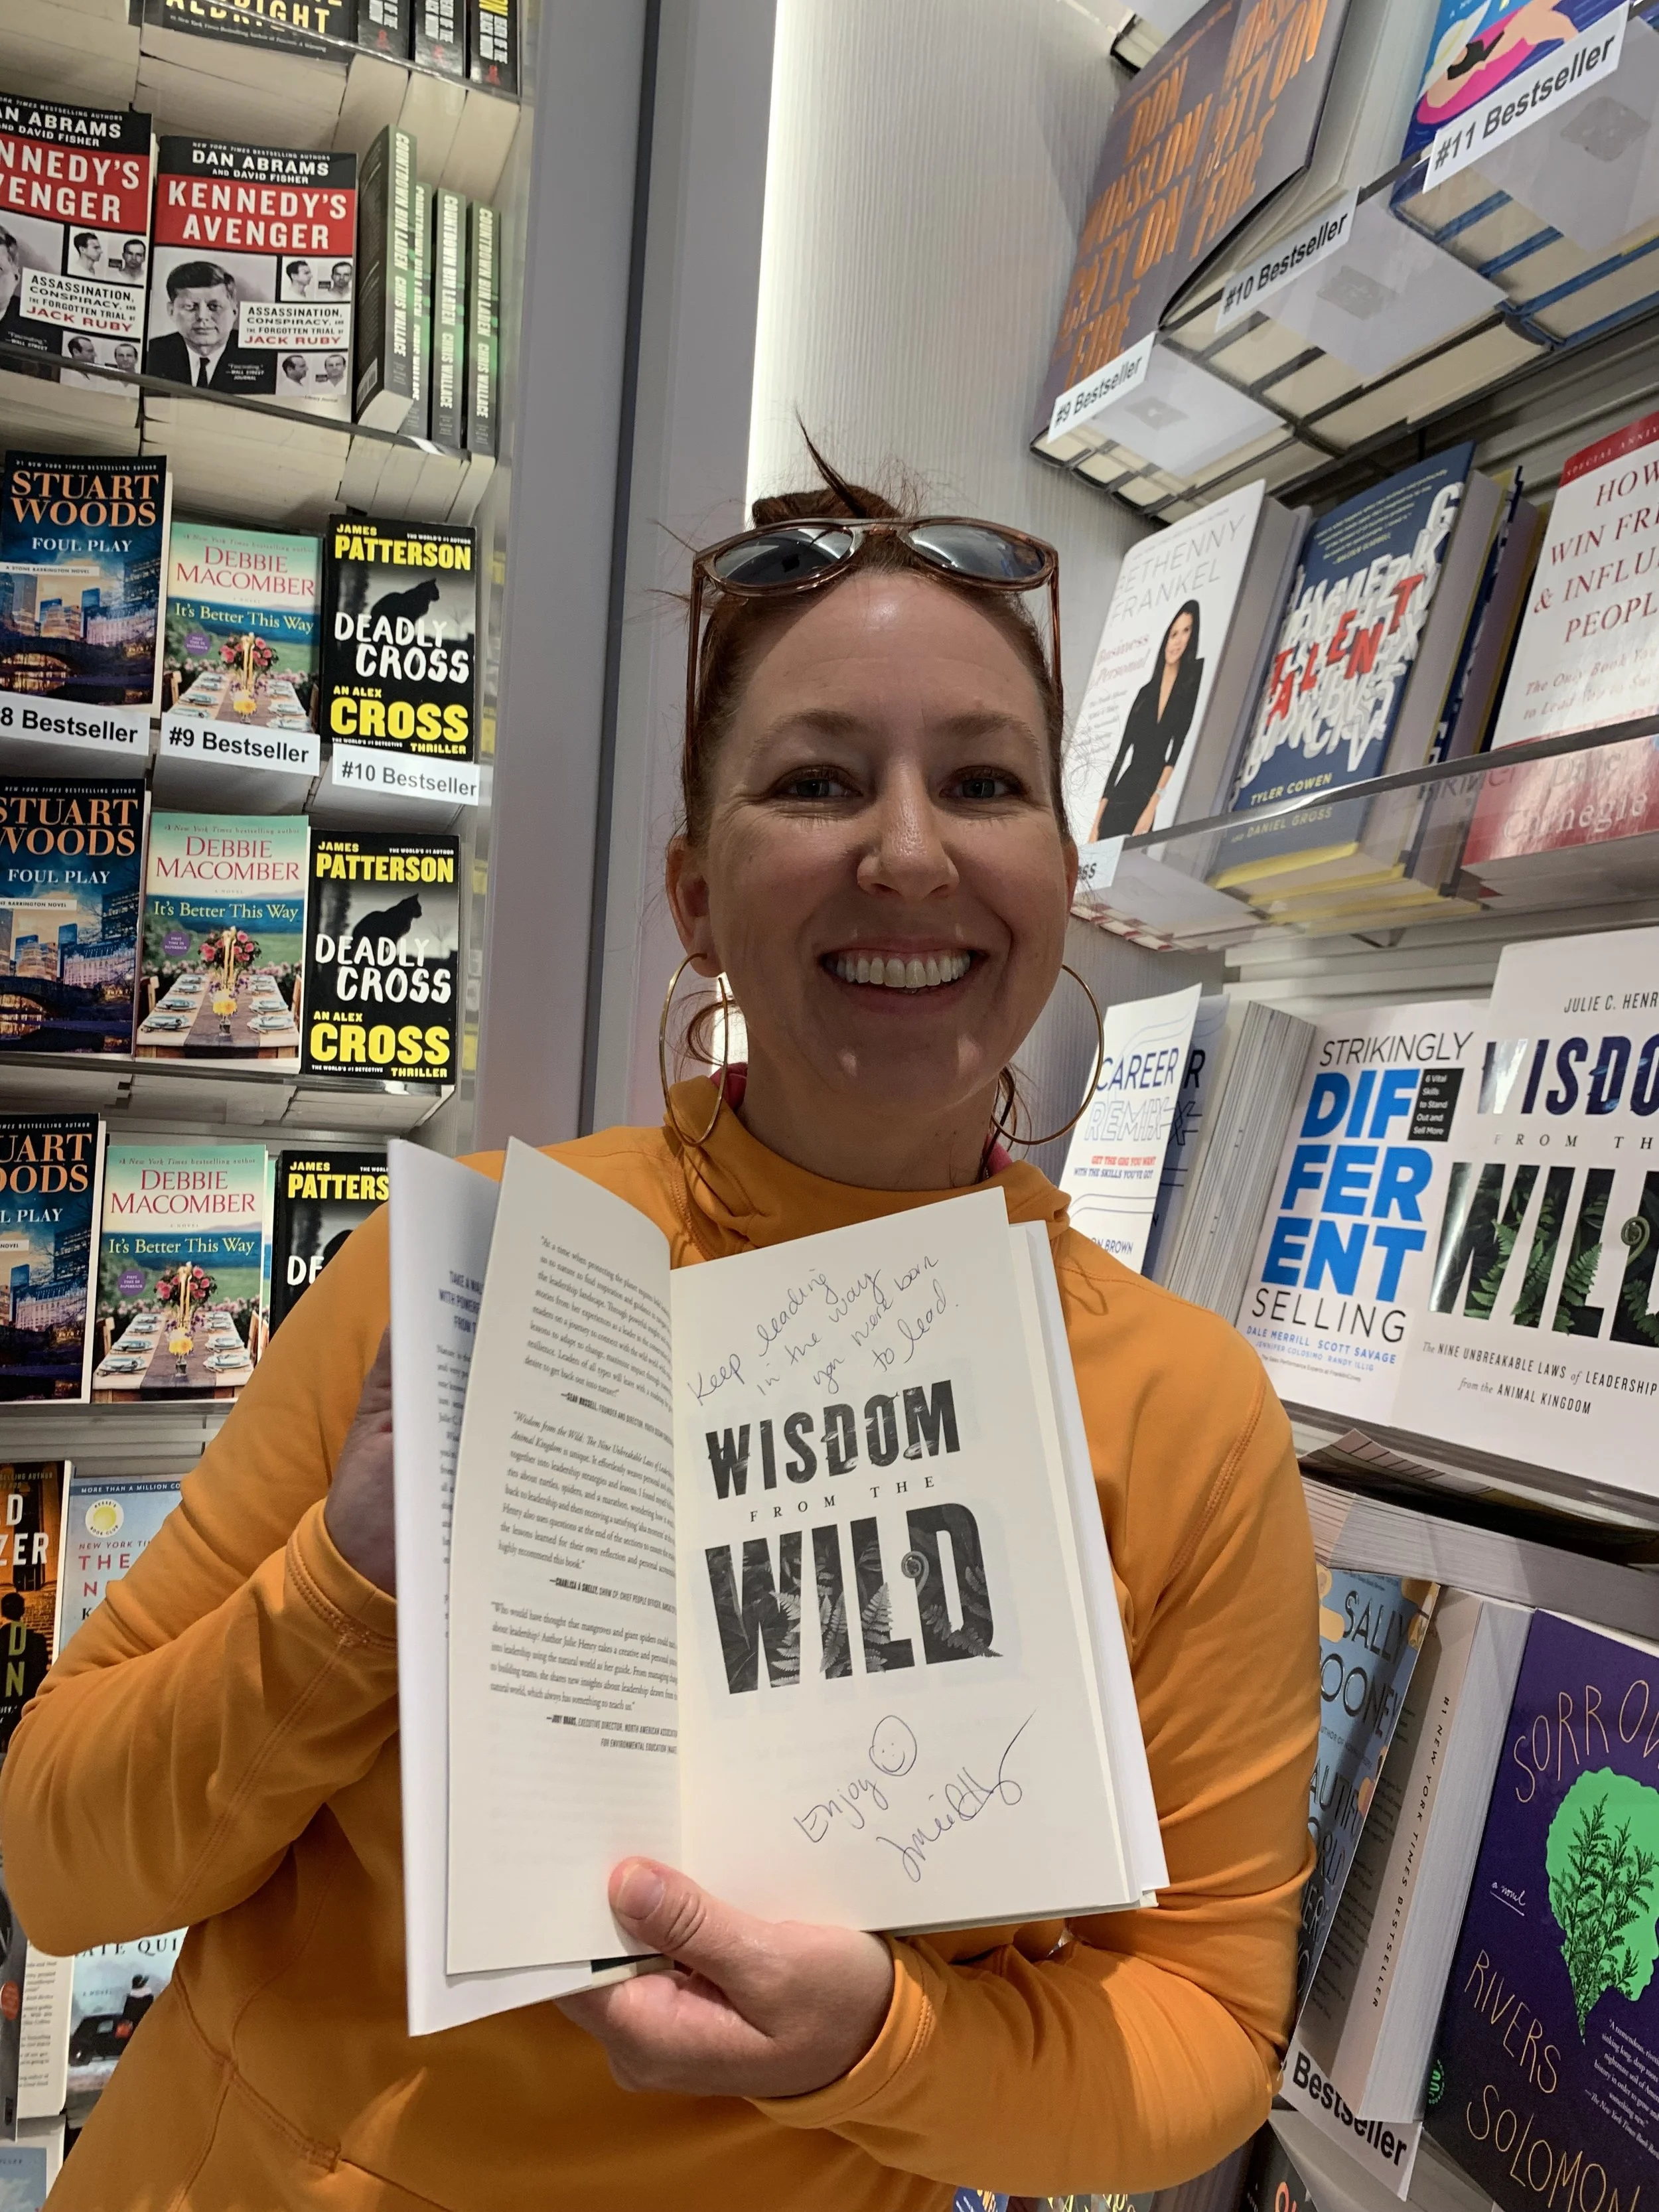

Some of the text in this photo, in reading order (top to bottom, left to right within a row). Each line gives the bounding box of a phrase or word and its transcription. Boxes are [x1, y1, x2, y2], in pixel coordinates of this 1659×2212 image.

[1434, 35, 1616, 170] #11 Bestseller
[192, 149, 330, 177] DAN ABRAMS
[253, 149, 298, 159] BESTSELLING
[234, 169, 266, 181] DAVID
[270, 173, 309, 185] FISHER
[169, 180, 347, 220] KENNEDY'S
[182, 213, 329, 250] AVENGER
[394, 133, 410, 357] COUNTDOWN BIN LADEN CHRIS WALLACE
[1222, 214, 1348, 315] #10 Bestseller
[247, 317, 332, 326] CONSPIRACY,
[248, 307, 342, 318] ASSASSINATION,
[244, 336, 341, 345] JACK RUBY
[1054, 356, 1143, 428] #9 Bestseller
[11, 470, 159, 500] STUART
[11, 496, 157, 527] WOODS
[32, 537, 132, 552] FOUL PLAY
[204, 546, 288, 573] DEBBIE
[1551, 524, 1605, 566] WIN
[177, 562, 315, 596] MACOMBER
[1534, 588, 1554, 614] &
[22, 710, 138, 743] Bestseller
[169, 727, 309, 763] #9 Bestseller
[341, 761, 477, 798] #10 Bestseller
[1251, 773, 1333, 806] TYLER COWEN
[1246, 806, 1333, 838] DANIEL GROSS
[185, 836, 273, 859] DEBBIE
[318, 841, 359, 853] JAMES
[156, 857, 300, 881] MACOMBER
[316, 852, 454, 883] PATTERSON
[154, 900, 299, 922] It's Better This Way
[315, 933, 430, 967] DEADLY
[336, 966, 451, 1004] CROSS
[314, 1011, 363, 1022] AN ALEX
[1563, 995, 1617, 1013] JULIE C.
[310, 1022, 451, 1065] CROSS
[1319, 1031, 1474, 1067] STRIKINGLY
[391, 1067, 447, 1078] THRILLER
[1096, 1047, 1180, 1092] CAREER
[1432, 1073, 1447, 1084] Vital
[1299, 1068, 1421, 1140] DIF
[1419, 1100, 1447, 1109] to Stand
[1422, 1086, 1439, 1096] Skills
[1084, 1096, 1172, 1142] REMIX
[1413, 1126, 1444, 1136] Sell More
[1416, 1113, 1443, 1122] Out and
[1494, 1133, 1579, 1148] FROM
[290, 1161, 330, 1171] JAMES
[1074, 1167, 1154, 1179] WITH THE SKILLS YOU'VE GOT
[1104, 1155, 1118, 1166] THE
[1130, 1157, 1141, 1167] YOU
[1142, 1156, 1157, 1167] WANT
[1280, 1143, 1433, 1222] FER
[1104, 1238, 1134, 1255] BROWN
[1261, 1215, 1427, 1303] ENT
[812, 1256, 940, 1394] you were born
[1252, 1288, 1407, 1343] SELLING
[687, 1353, 745, 1406] Keep
[757, 1268, 839, 1358] leading
[757, 1268, 882, 1396] in the way
[1246, 1325, 1397, 1364] DALE MERRILL SCOTT SAVAGE
[873, 1348, 895, 1378] to
[1255, 1341, 1285, 1352] JENNIFER
[1287, 1347, 1323, 1360] COLOSIMO
[1327, 1355, 1351, 1367] RANDY
[1423, 1341, 1658, 1397] The NINE UNBREAKABLE LAWS of LEADERSHIP
[1457, 1377, 1591, 1415] from the ANIMAL KINGDOM
[705, 1379, 962, 1500] WISDOM
[750, 1476, 936, 1522] FROM THE
[79, 1542, 101, 1550] NEW
[78, 1554, 131, 1571] THE
[705, 1503, 1003, 1695] WILD
[794, 1774, 889, 1843] Enjoy
[1371, 1696, 1451, 2008] #1 NEW YORK TIMES BESTSELLER
[1500, 1885, 1526, 1907] novel
[1464, 1949, 1562, 2094] RIVERS
[1293, 2050, 1407, 2167] Bestseller
